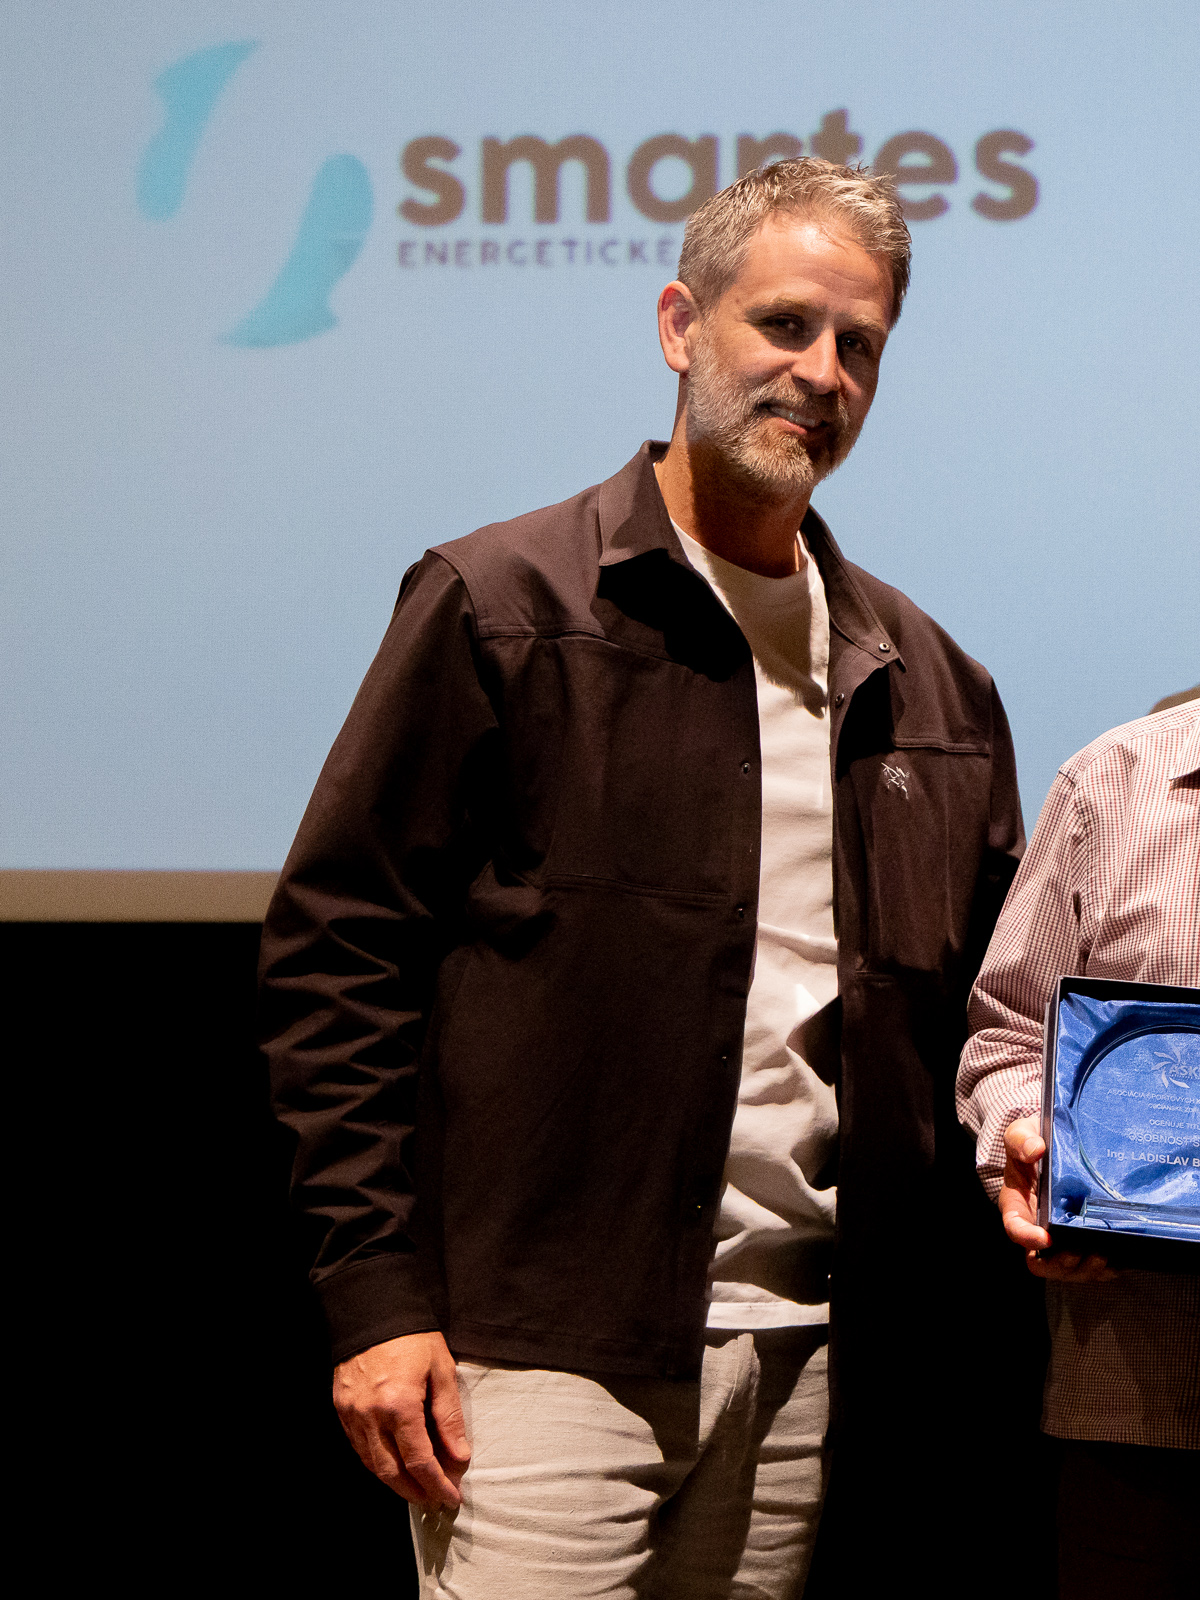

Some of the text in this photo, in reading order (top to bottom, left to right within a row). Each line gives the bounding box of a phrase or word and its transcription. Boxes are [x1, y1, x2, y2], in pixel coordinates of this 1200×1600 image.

[398, 108, 1039, 226] smartes
[1106, 1148, 1127, 1161] Ing.
[1131, 1151, 1190, 1166] LADISLAV
